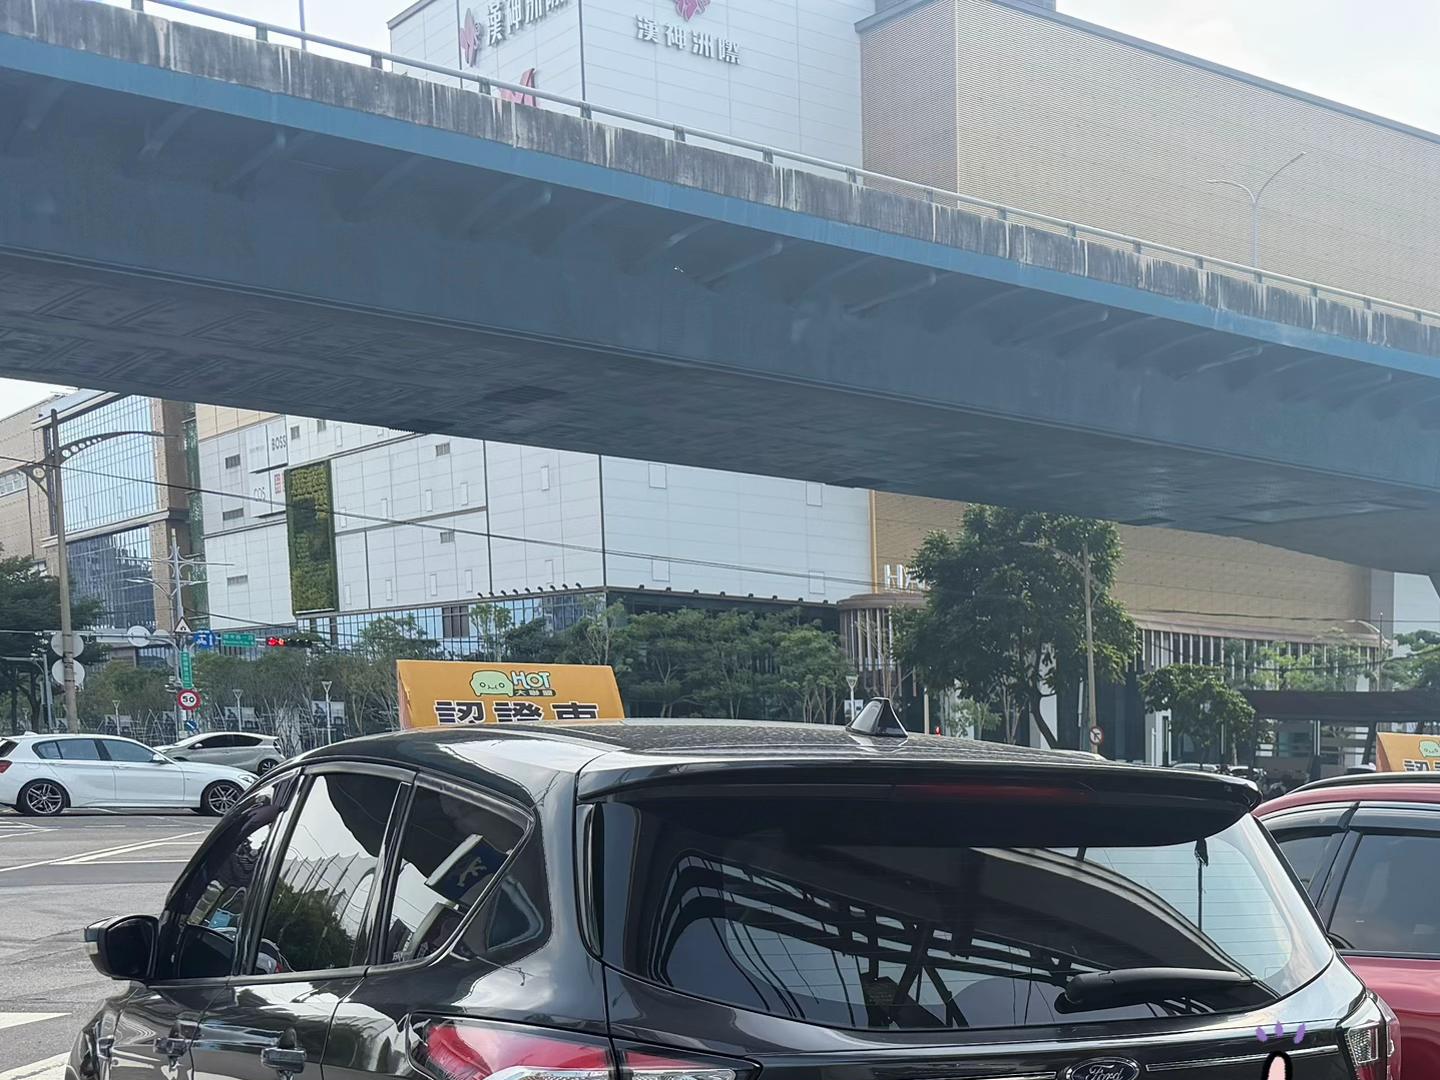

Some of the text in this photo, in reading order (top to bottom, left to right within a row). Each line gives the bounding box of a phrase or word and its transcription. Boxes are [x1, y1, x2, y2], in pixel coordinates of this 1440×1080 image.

[487, 0, 569, 47] 漢神洲
[635, 15, 741, 65] 漢神洲際
[271, 434, 287, 451] BOSS
[510, 670, 551, 689] HOT
[182, 695, 196, 703] 50
